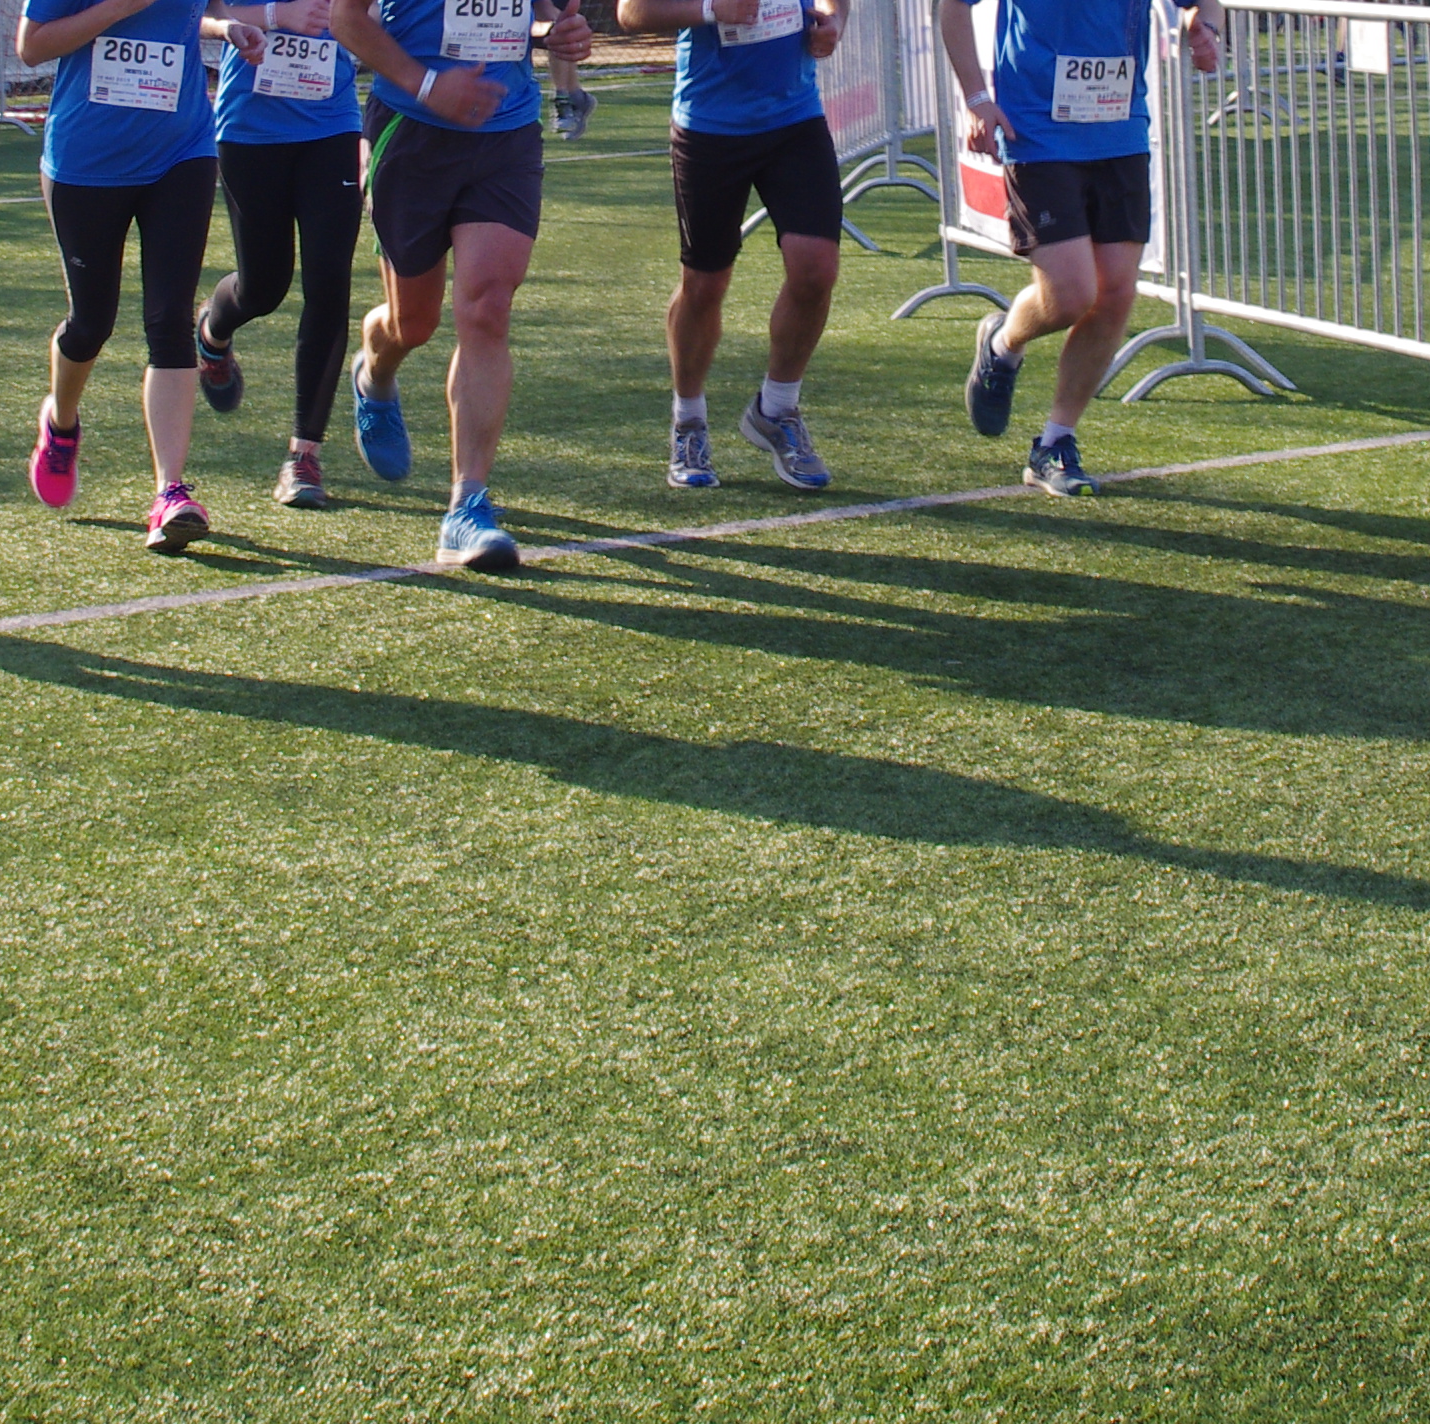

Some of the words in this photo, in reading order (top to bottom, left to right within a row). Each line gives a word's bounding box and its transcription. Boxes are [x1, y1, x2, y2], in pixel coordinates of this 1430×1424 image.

[104, 39, 175, 67] 260-C
[272, 35, 330, 62] 259-C
[1066, 60, 1128, 80] 260-A
